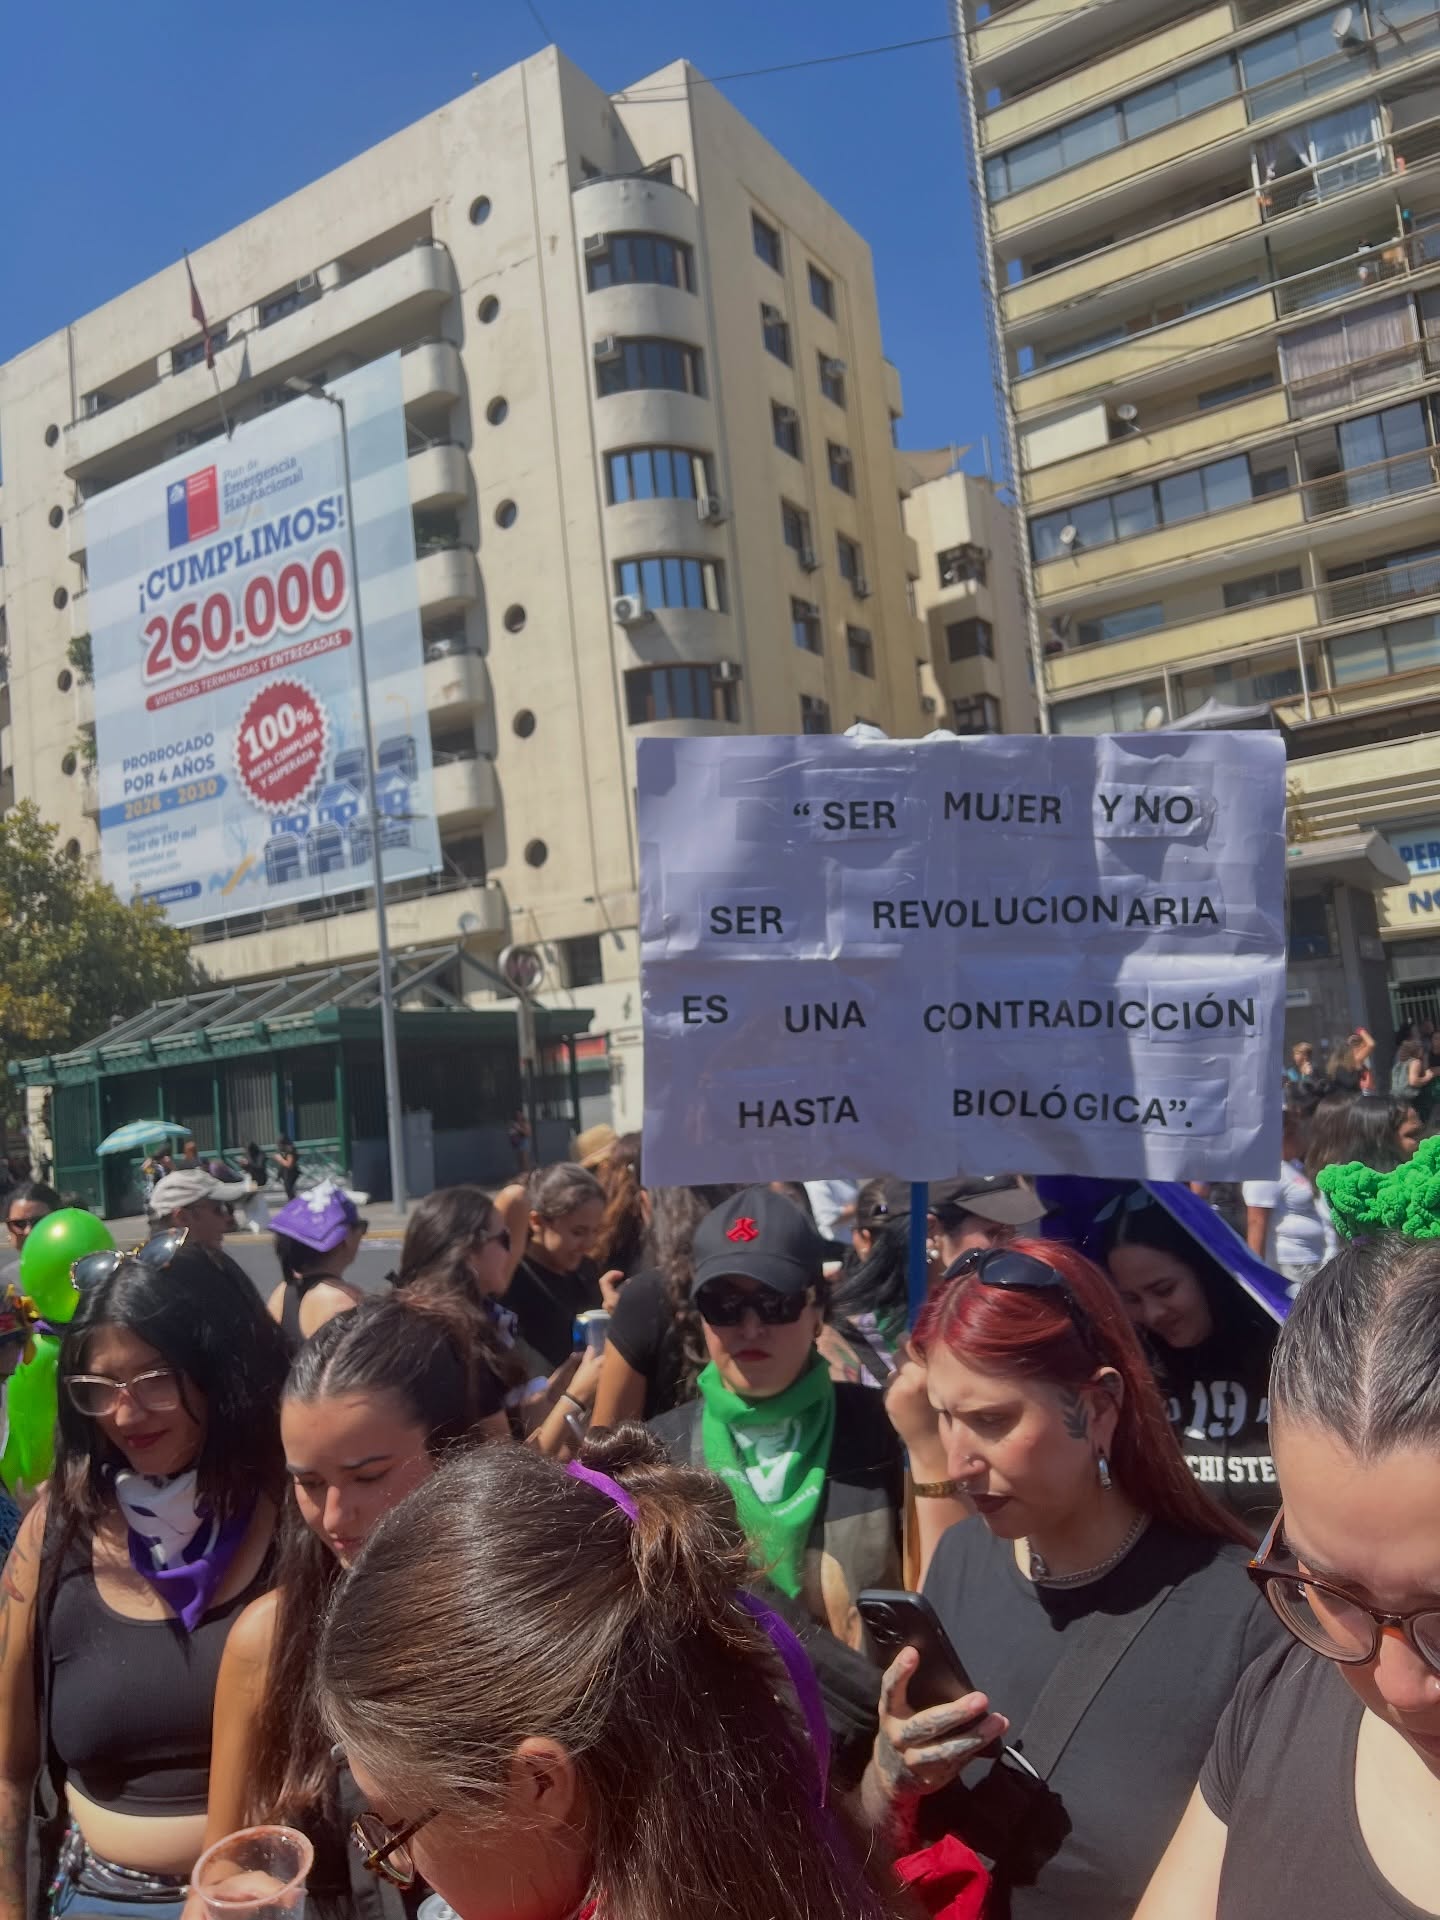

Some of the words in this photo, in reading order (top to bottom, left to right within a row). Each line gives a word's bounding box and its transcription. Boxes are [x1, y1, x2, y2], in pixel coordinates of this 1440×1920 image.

[139, 495, 345, 613] ¡CUMPLIMOS!
[144, 549, 345, 677] 260.000
[201, 662, 260, 690] TERMINADAS
[270, 634, 342, 668] ENTREGADAS
[123, 732, 214, 773] PRORROGADO
[243, 703, 314, 761] 100%
[124, 772, 154, 795] POR
[159, 768, 167, 784] 4
[173, 753, 215, 780] AÑOS
[943, 792, 1063, 824] MUJER
[1100, 795, 1123, 822] Y
[1134, 795, 1195, 825] NO
[709, 905, 783, 935] SER
[872, 895, 1220, 930] REVOLUCIONARIA
[682, 996, 729, 1025] ES
[785, 1000, 867, 1033] UNA
[923, 993, 1256, 1034] CONTRADICCIÓN
[738, 1095, 860, 1128] HASTA
[1184, 1380, 1248, 1440] 19
